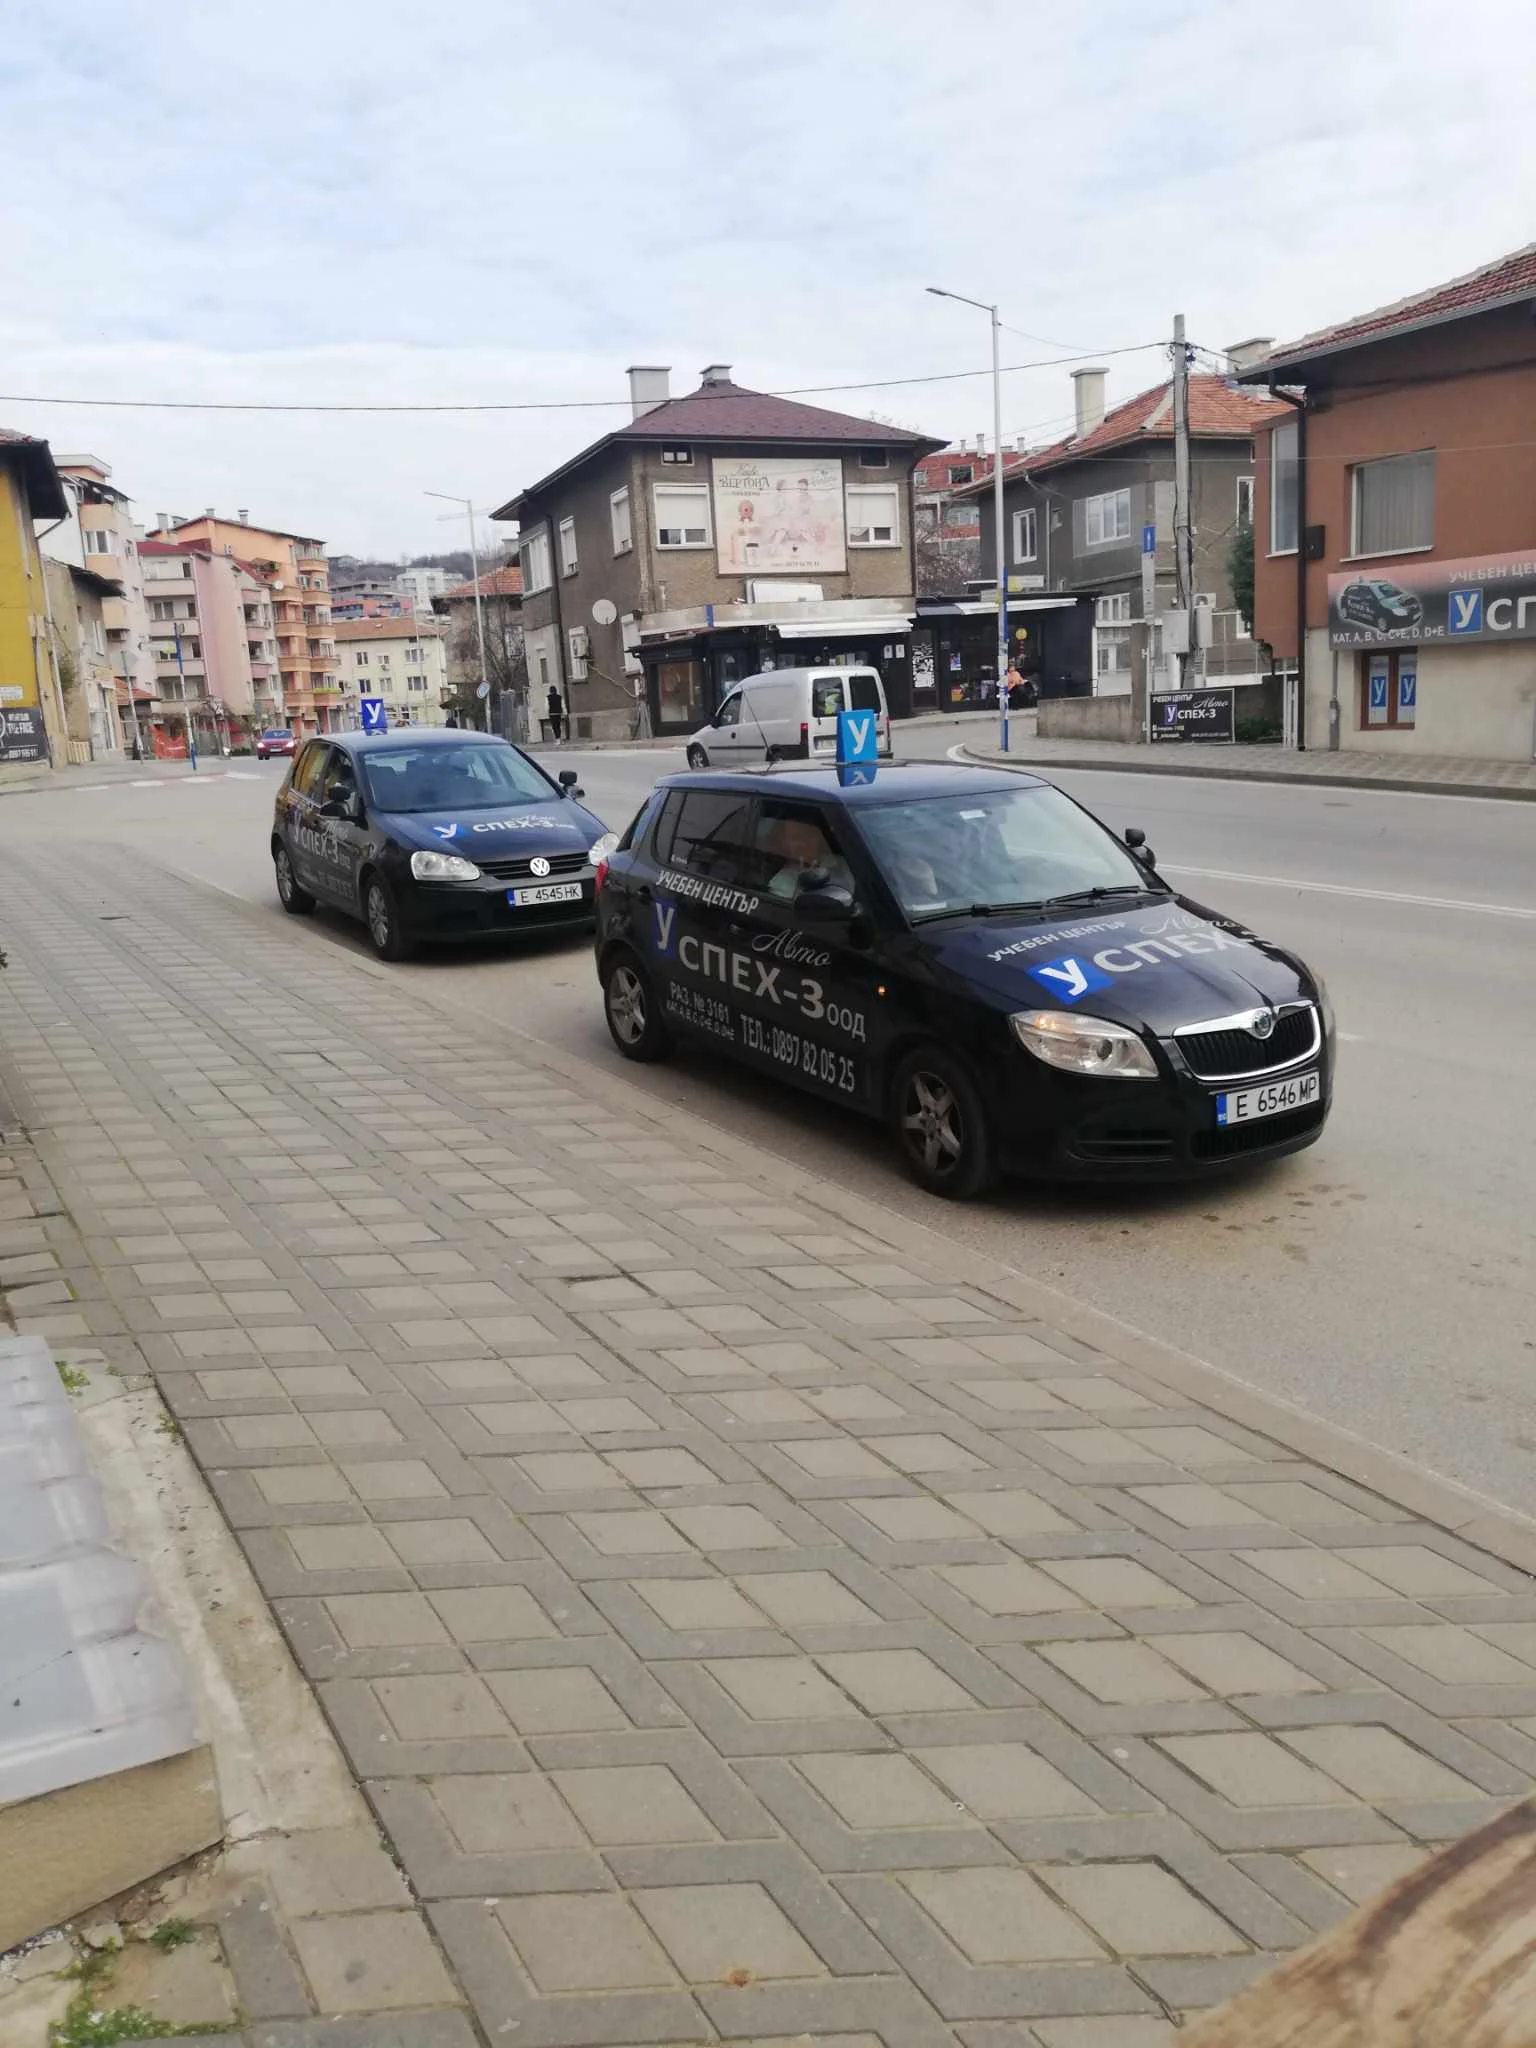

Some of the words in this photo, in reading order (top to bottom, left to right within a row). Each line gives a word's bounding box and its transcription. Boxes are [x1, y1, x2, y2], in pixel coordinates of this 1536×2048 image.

[1448, 566, 1506, 583] УЧЕБЕН
[365, 702, 382, 724] У
[847, 718, 871, 756] У
[520, 890, 530, 904] E
[535, 886, 564, 902] 4545
[565, 885, 580, 899] HK
[655, 869, 704, 899] УЧЕБЕН
[703, 882, 760, 916] ЦЕНТЪР
[752, 928, 831, 967] Авто
[987, 933, 1058, 963] УЧЕБЕН
[1058, 917, 1128, 943] ЦЕНТЪР
[772, 1026, 800, 1067] 0897
[802, 1039, 818, 1076] 82
[820, 1048, 836, 1084] 05
[838, 1056, 855, 1093] 25
[1235, 1093, 1249, 1119] E
[1257, 1082, 1297, 1113] 6546
[1299, 1075, 1318, 1102] MP
